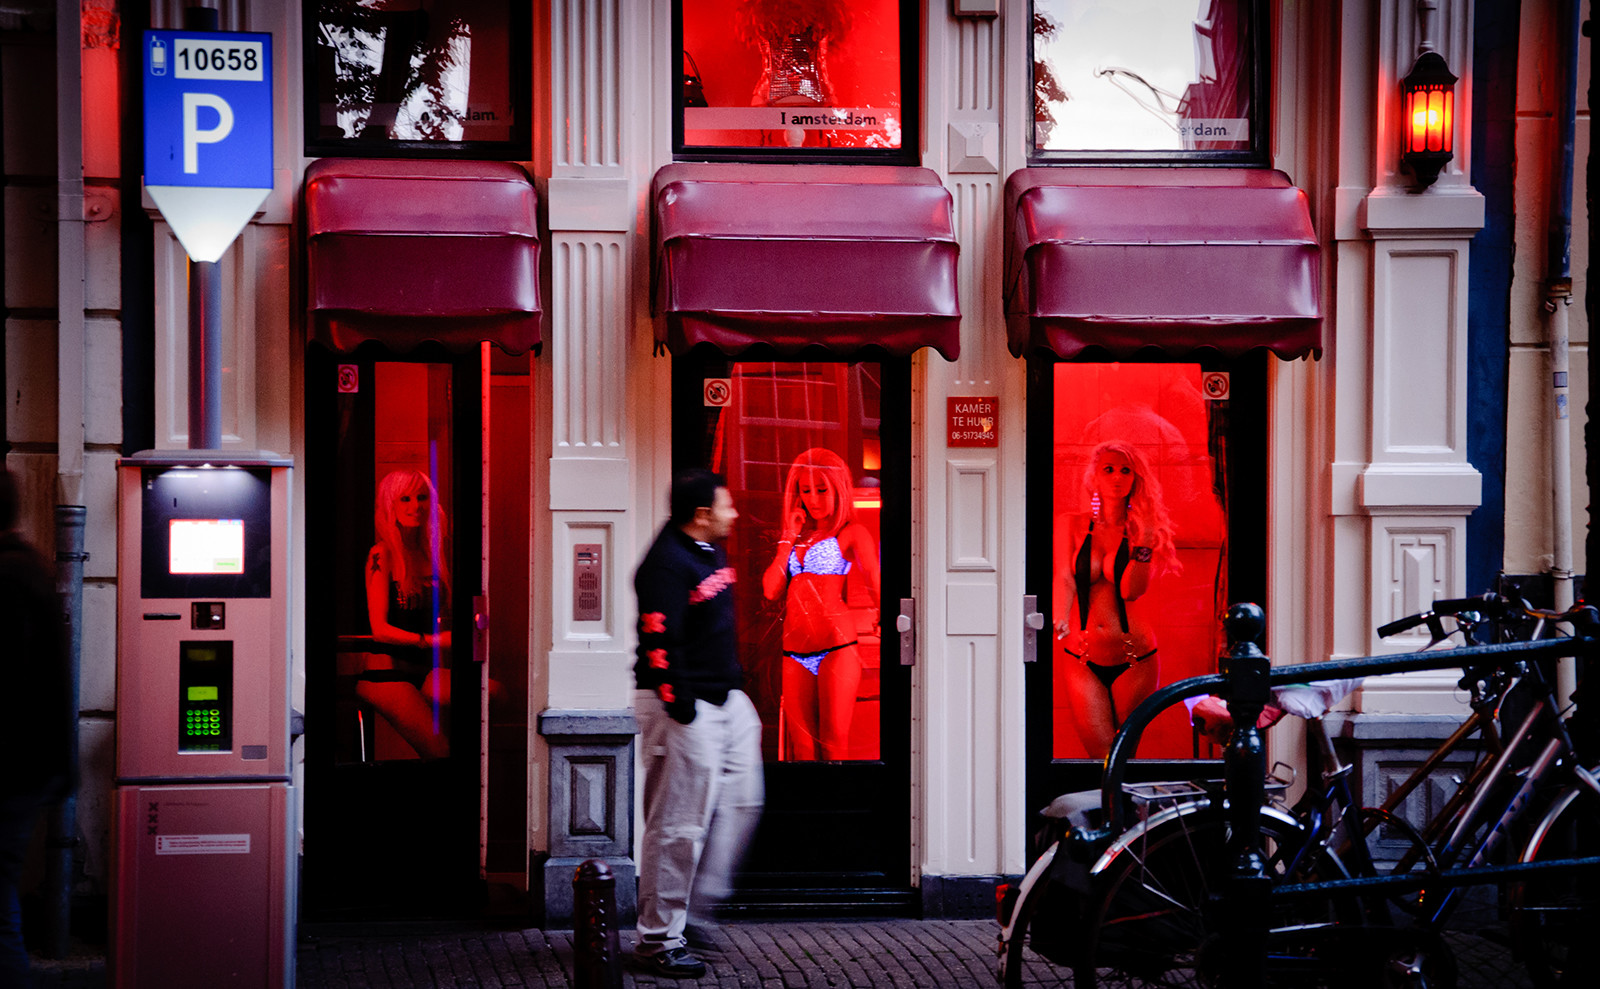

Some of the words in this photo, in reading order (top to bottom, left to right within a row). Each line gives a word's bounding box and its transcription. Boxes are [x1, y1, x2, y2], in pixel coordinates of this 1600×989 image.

[179, 48, 257, 71] 10658
[781, 111, 786, 124] I
[183, 92, 234, 174] P
[955, 403, 991, 413] KAMER
[952, 416, 964, 426] TE
